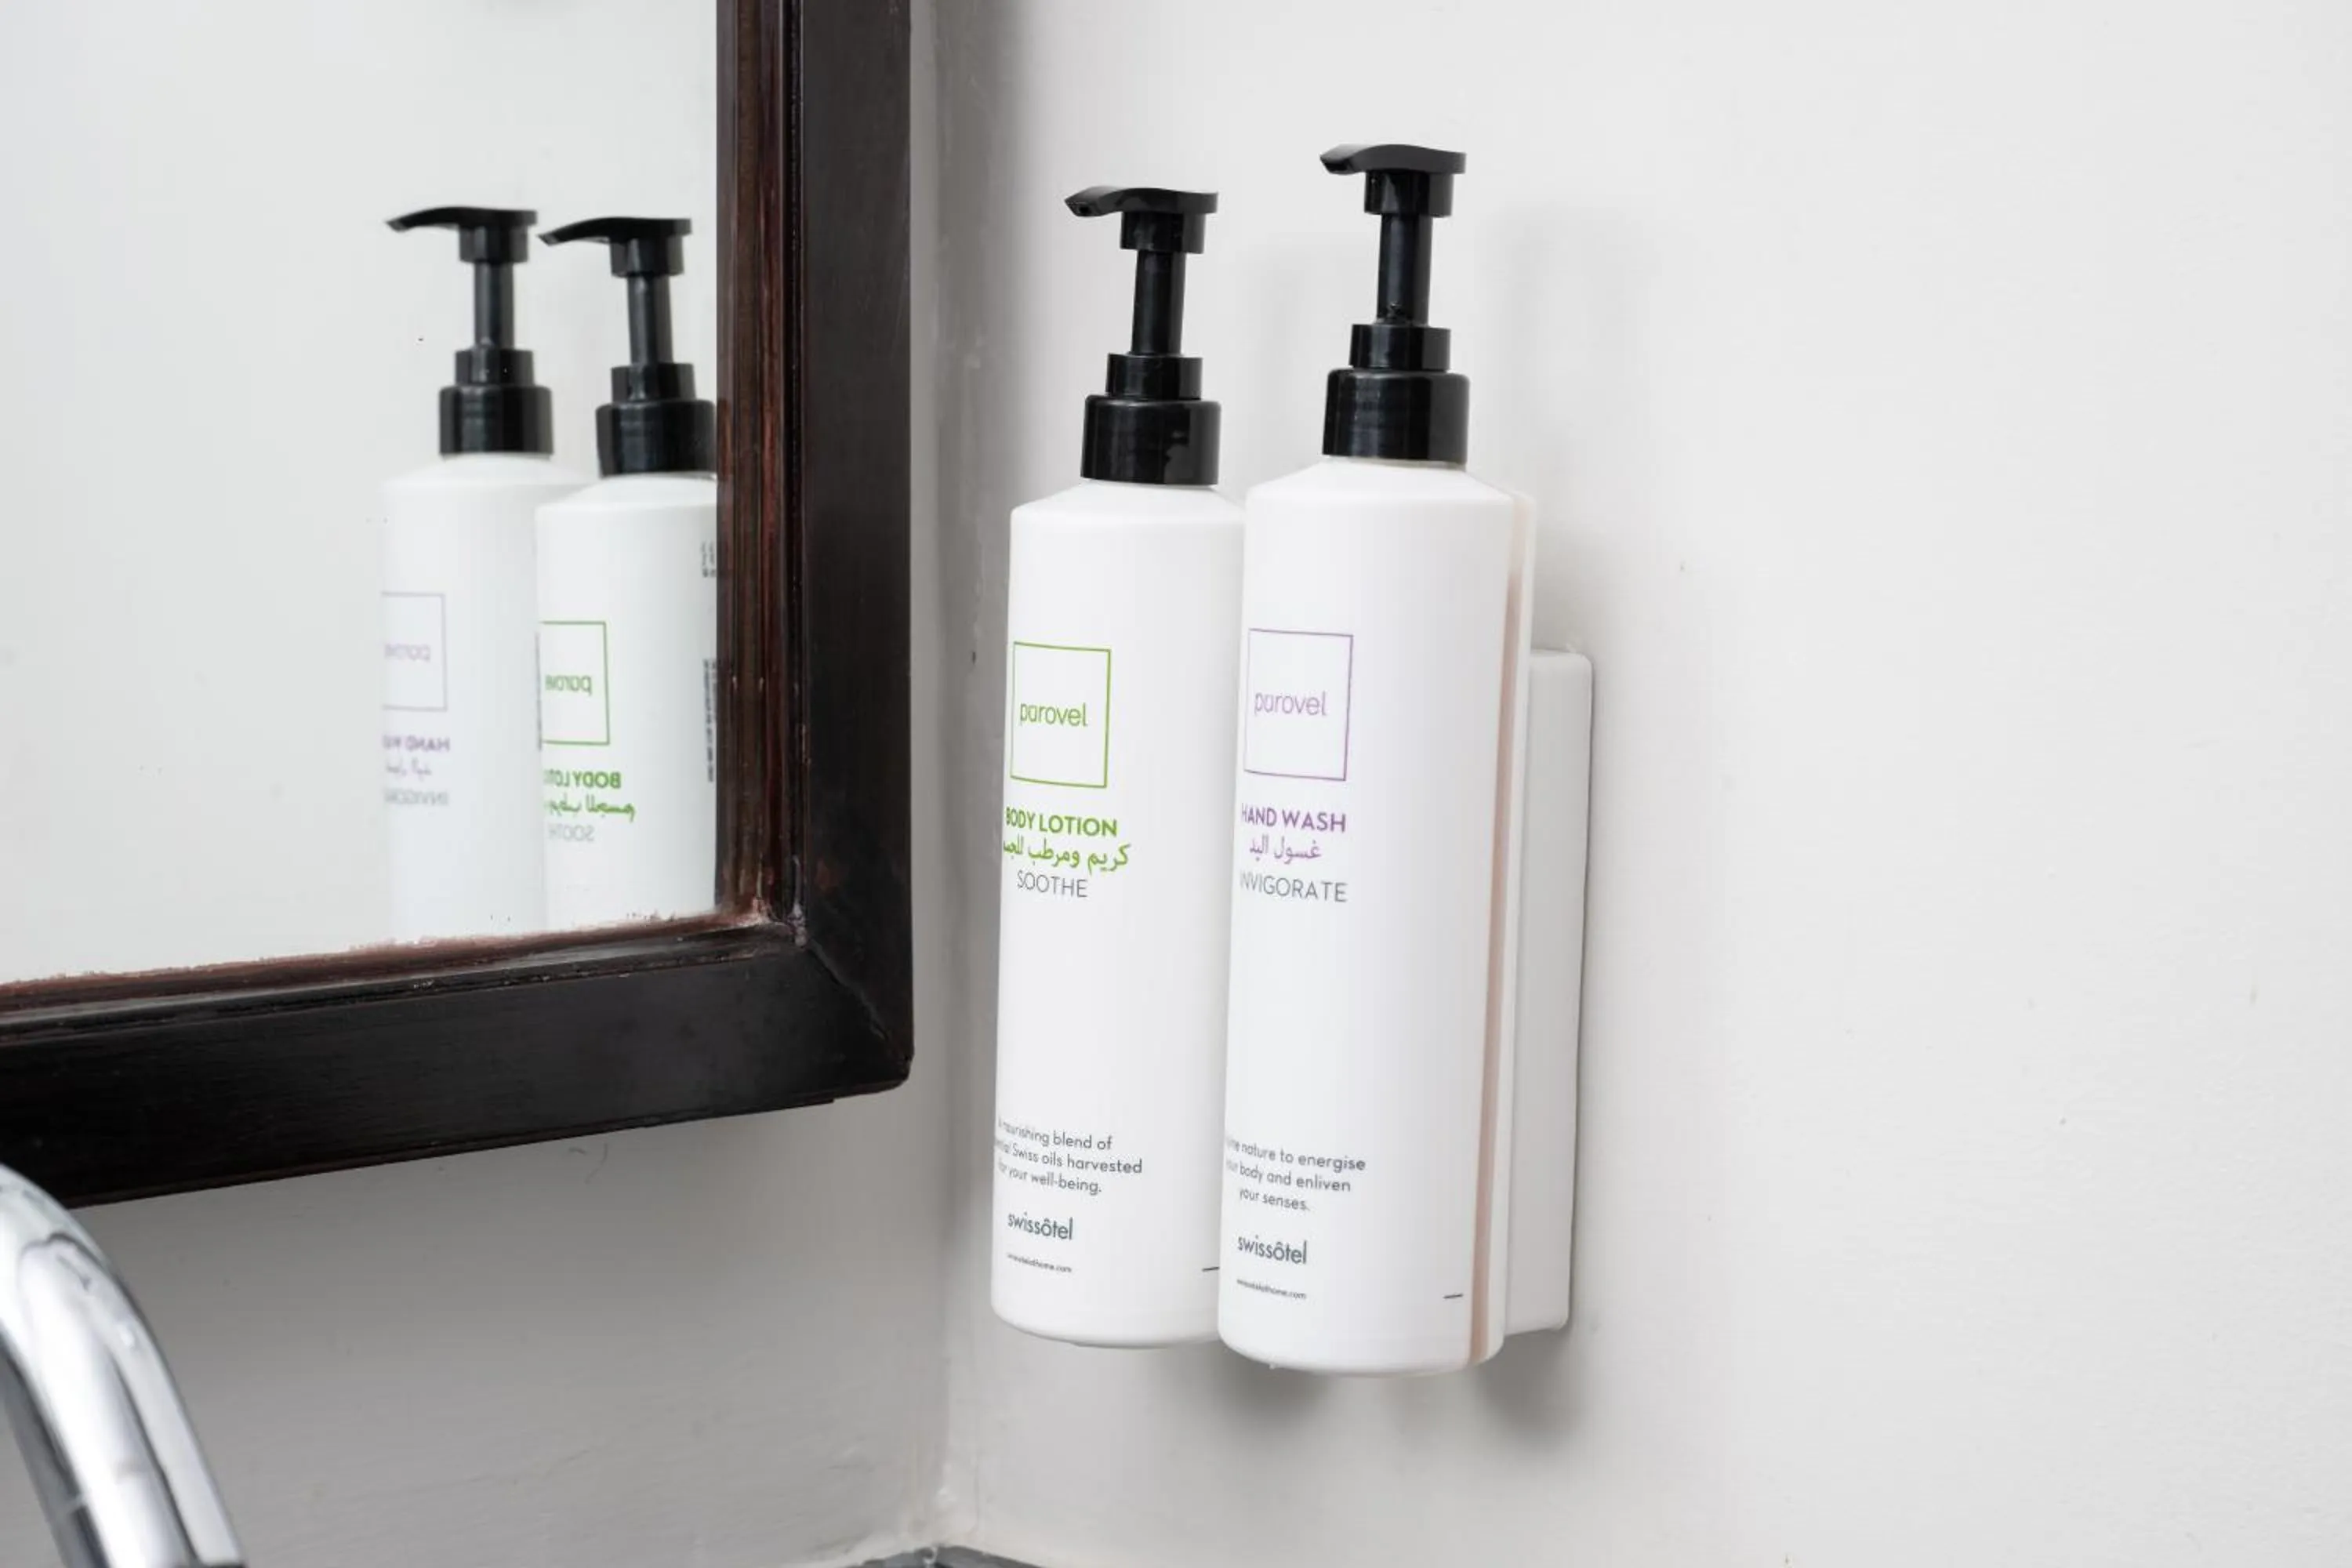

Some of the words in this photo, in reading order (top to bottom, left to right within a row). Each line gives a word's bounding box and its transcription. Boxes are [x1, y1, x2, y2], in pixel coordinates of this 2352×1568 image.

[1006, 806, 1036, 829] BODY
[1039, 813, 1118, 837] LOTION
[1242, 803, 1277, 827] HAND
[1282, 809, 1347, 833] WASH
[1087, 844, 1131, 877] كريم
[1017, 869, 1089, 898] SOOTHE
[1053, 1130, 1092, 1149] blend
[1097, 1136, 1112, 1150] of
[1041, 1151, 1062, 1167] oils
[1067, 1154, 1142, 1174] harvested
[1241, 1142, 1276, 1161] nature
[1279, 1149, 1294, 1164] to
[1298, 1155, 1367, 1174] energise
[1030, 1170, 1102, 1196] well-being.
[1240, 1160, 1263, 1184] body
[1266, 1171, 1291, 1186] and
[1296, 1174, 1352, 1192] enliven
[1007, 1211, 1073, 1240] swissôtel
[1237, 1234, 1307, 1265] swissôtel
